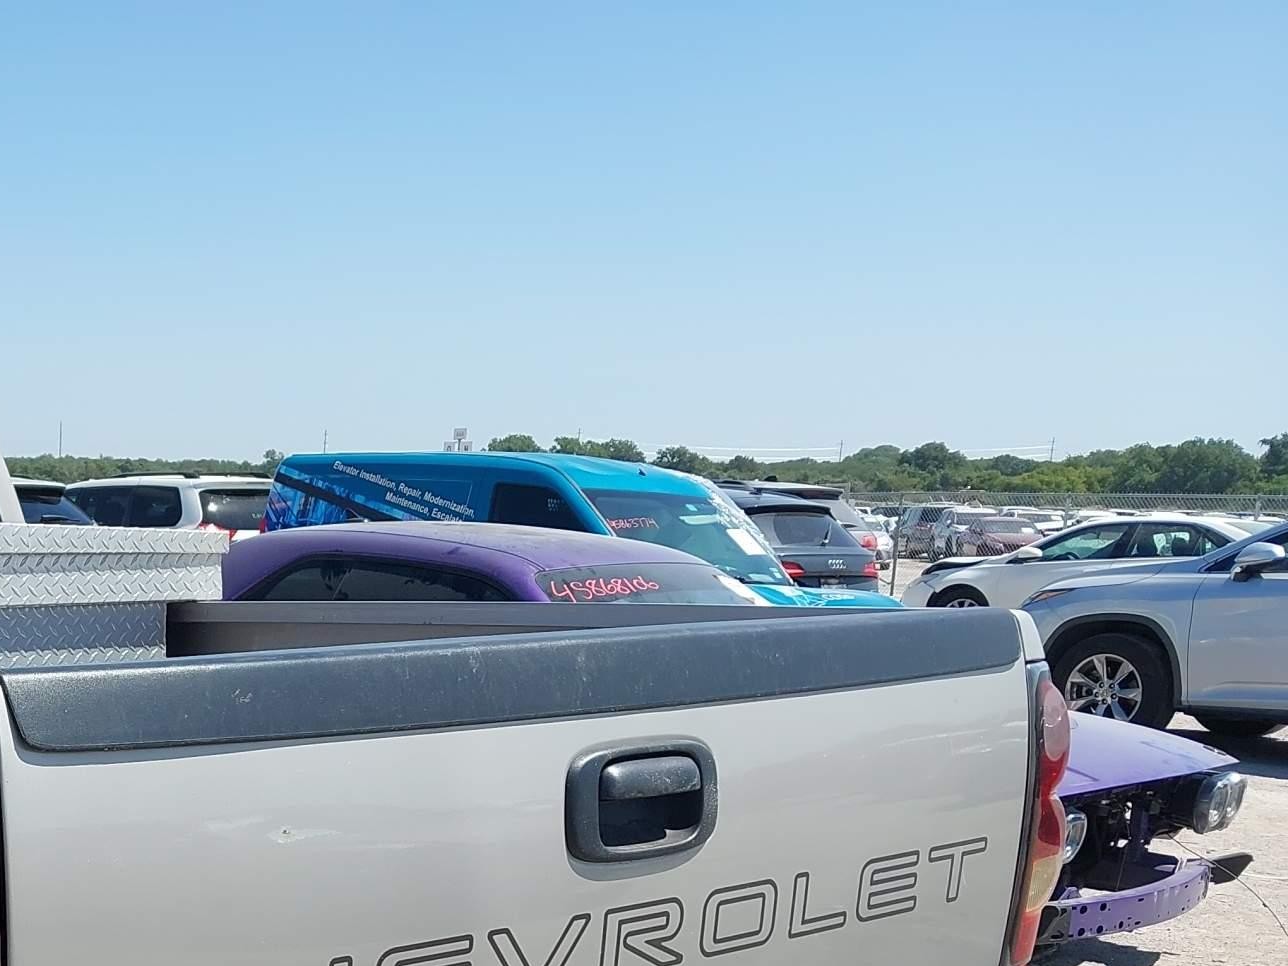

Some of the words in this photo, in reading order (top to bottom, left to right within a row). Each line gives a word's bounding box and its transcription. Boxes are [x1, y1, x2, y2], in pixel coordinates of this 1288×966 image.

[332, 460, 359, 476] Elevator
[359, 469, 397, 491] Installation,
[398, 482, 422, 500] Repair,
[423, 490, 475, 518] Modernization,
[385, 491, 430, 516] Maintenance,
[550, 575, 659, 603] 45868106
